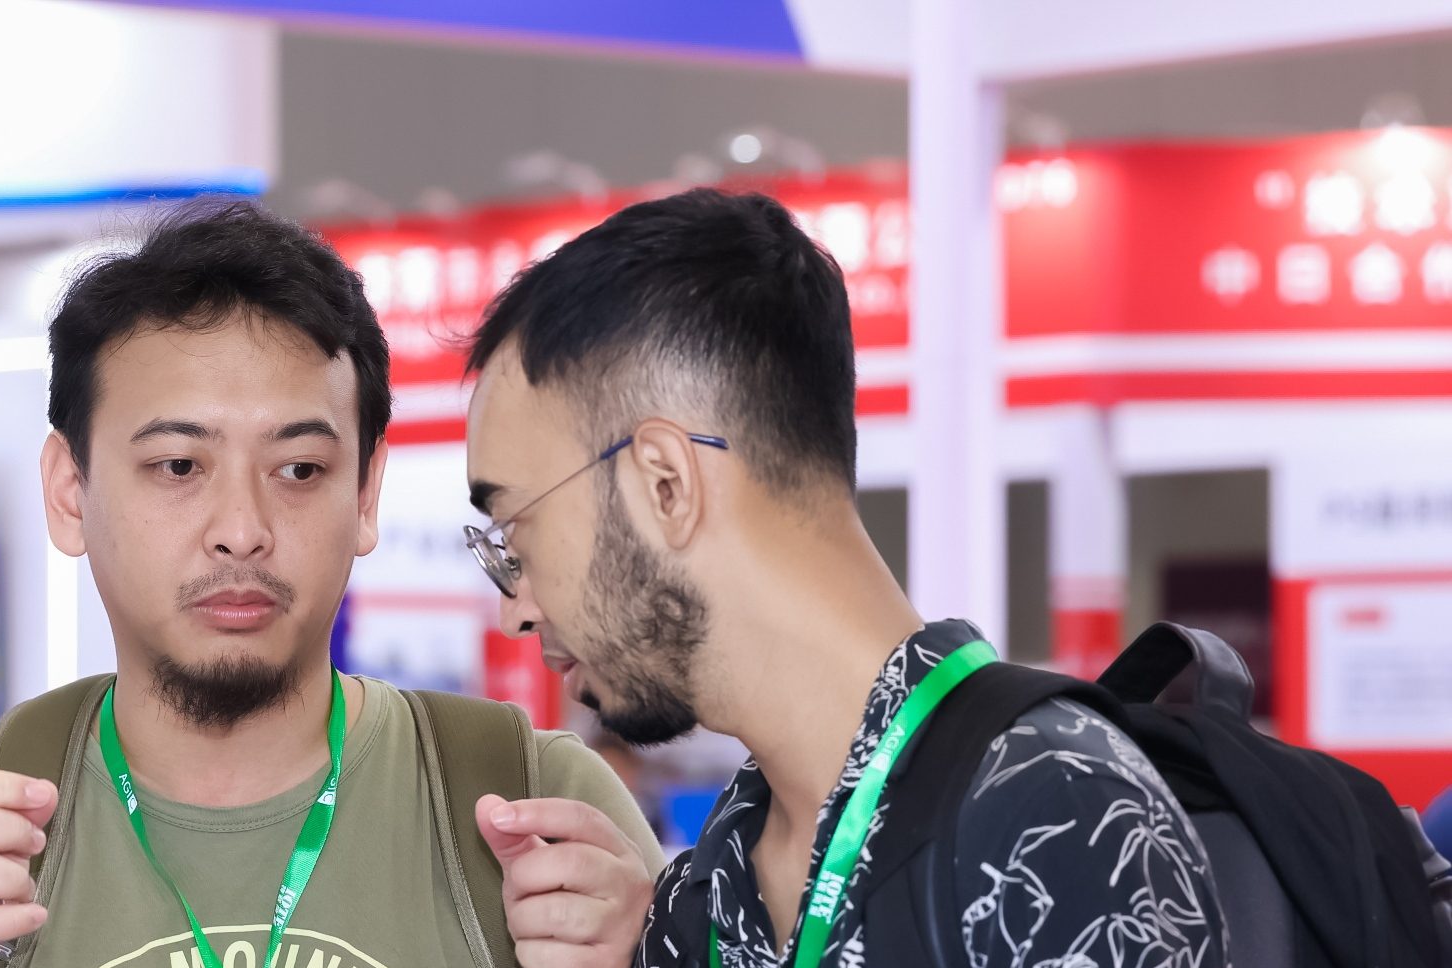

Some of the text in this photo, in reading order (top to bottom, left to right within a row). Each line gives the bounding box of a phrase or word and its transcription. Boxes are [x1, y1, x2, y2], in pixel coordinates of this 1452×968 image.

[118, 773, 139, 815] AGIC
[317, 777, 337, 806] GIC
[275, 886, 297, 934] IOTE
